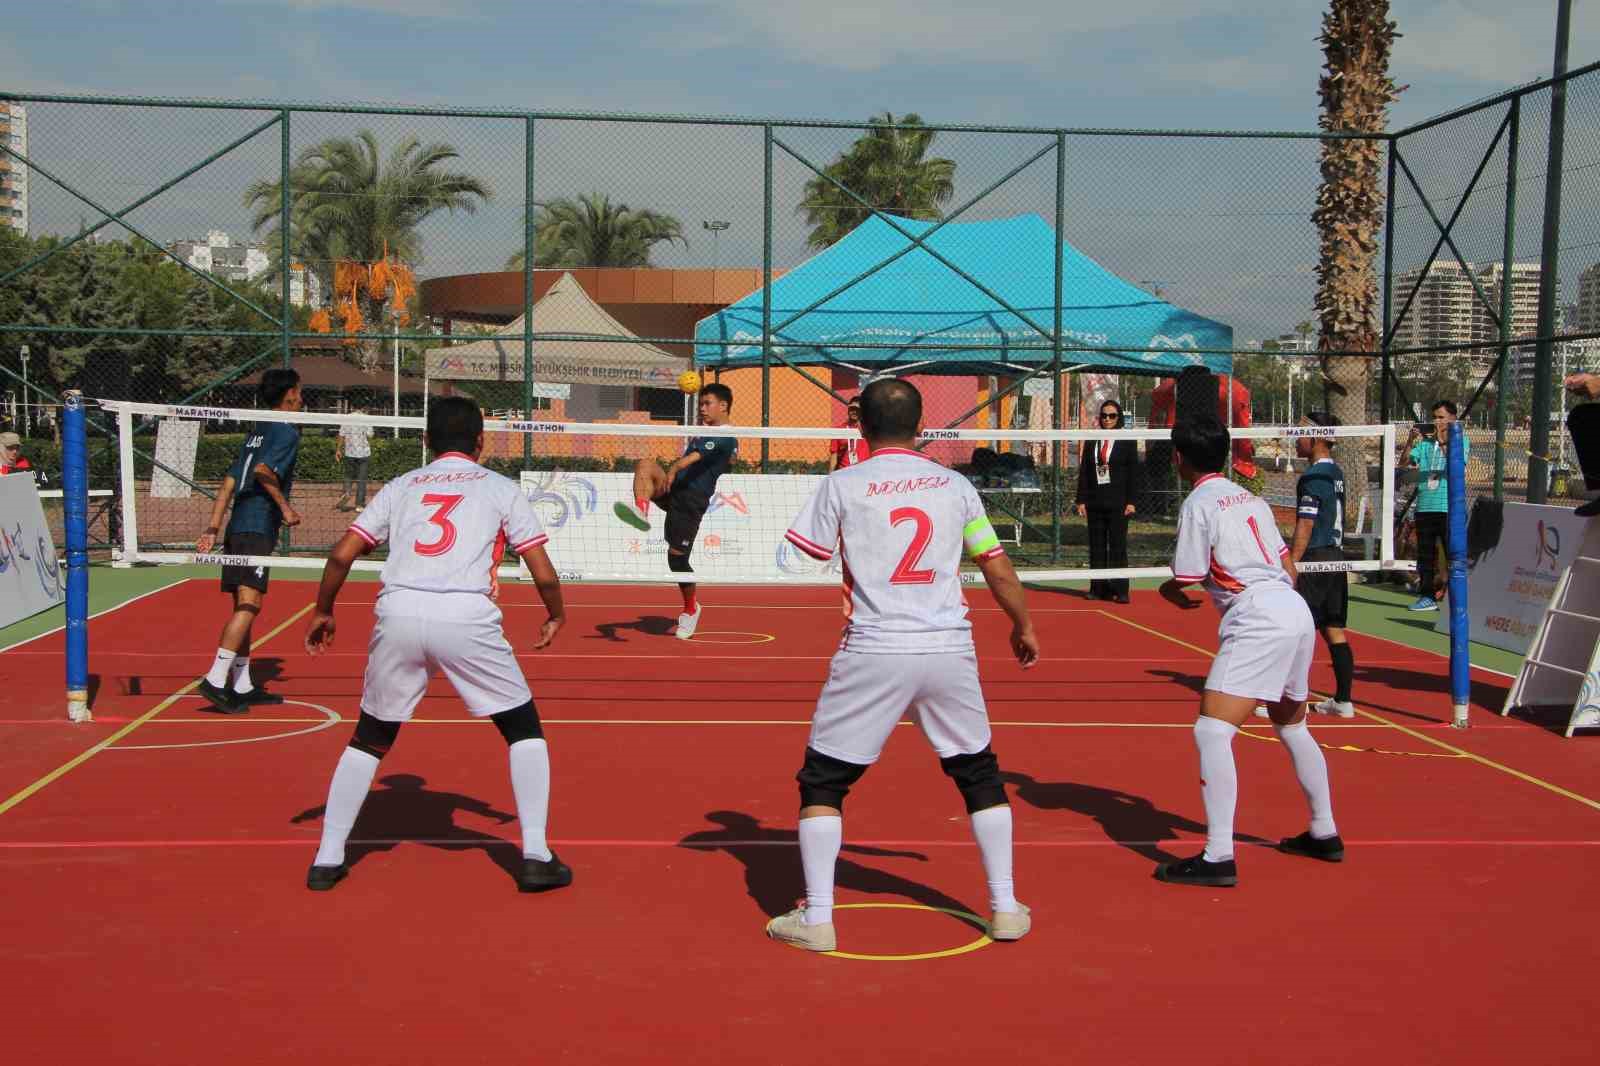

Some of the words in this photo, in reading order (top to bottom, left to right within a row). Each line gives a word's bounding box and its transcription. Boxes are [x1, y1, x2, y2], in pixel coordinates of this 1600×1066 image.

[533, 361, 590, 377] ÜYÜKŞEHİR
[175, 407, 230, 418] MARATHON
[512, 423, 565, 432] MARATHON
[1286, 428, 1335, 436] MARATHON
[414, 493, 465, 557] 3
[888, 506, 937, 585] 2
[1246, 515, 1275, 566] 1
[195, 556, 249, 566] MARATHON
[1304, 562, 1353, 572] MARATHON
